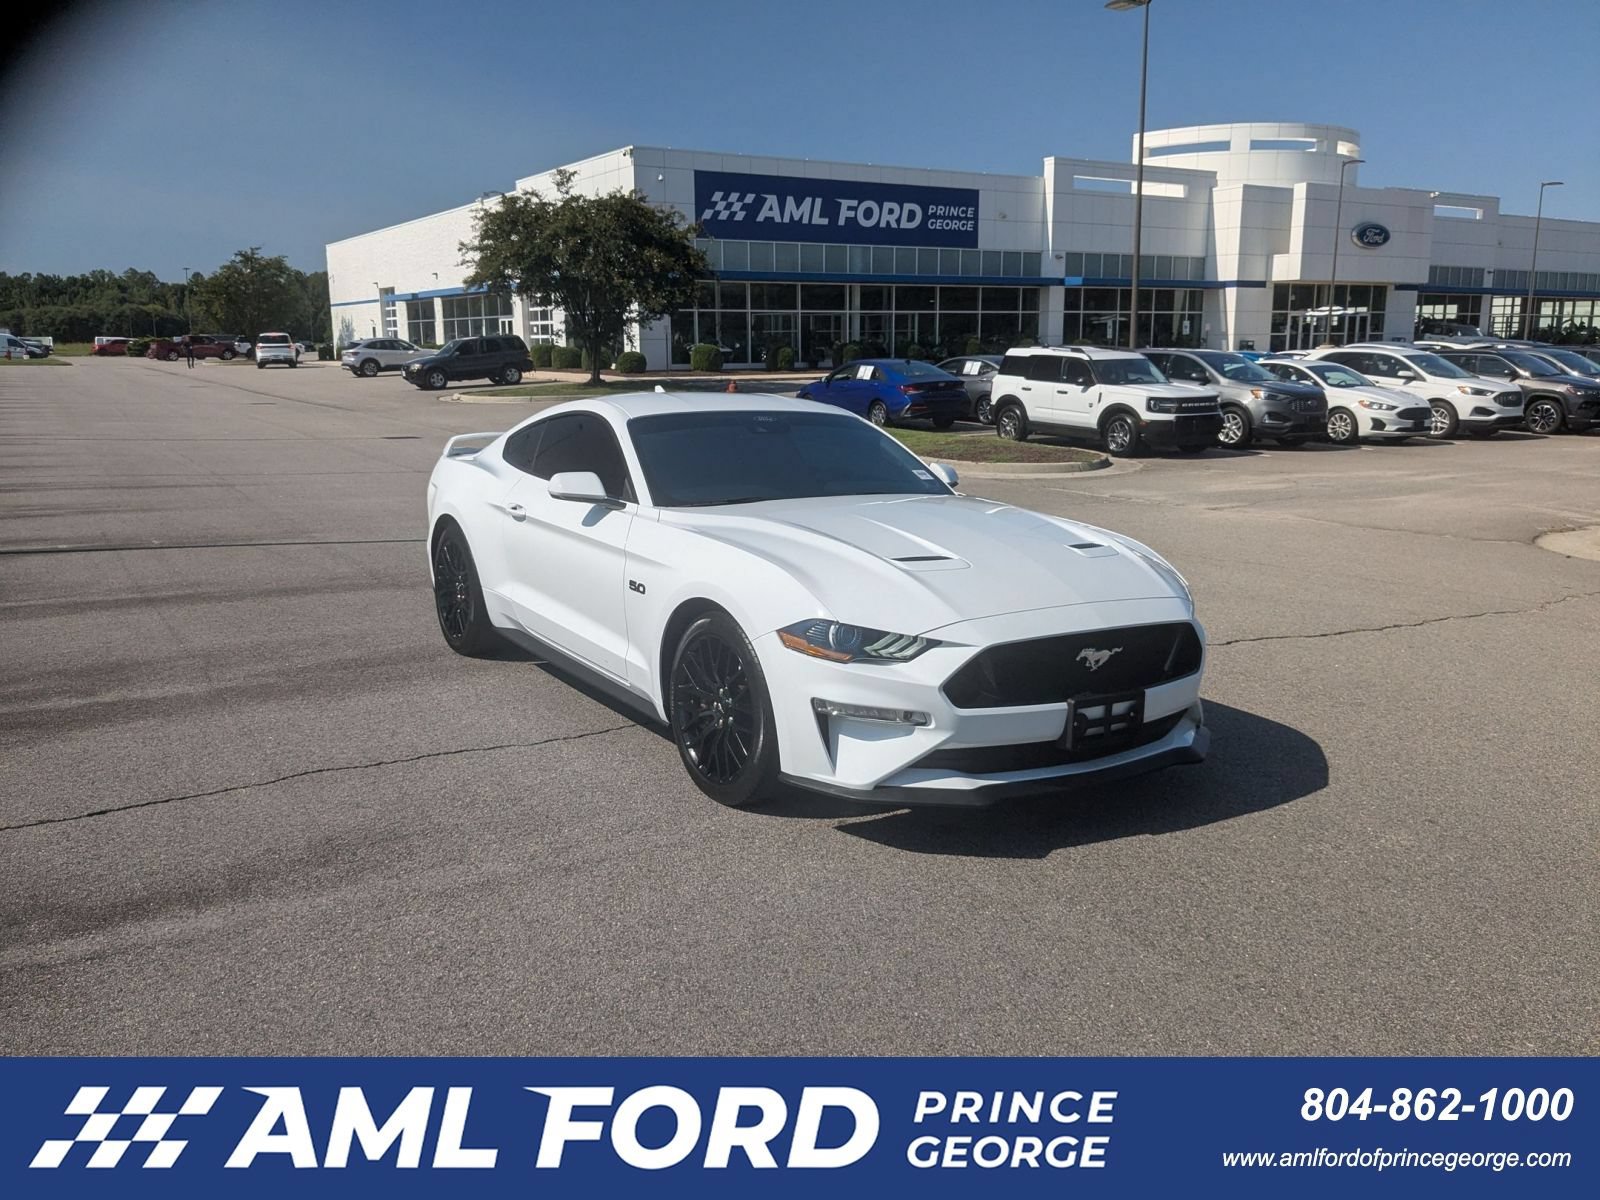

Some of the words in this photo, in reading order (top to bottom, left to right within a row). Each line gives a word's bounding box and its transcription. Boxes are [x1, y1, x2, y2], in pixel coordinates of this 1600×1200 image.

[755, 194, 829, 225] AML
[833, 198, 923, 229] FORD
[927, 205, 975, 217] PRINCE
[927, 219, 975, 230] GEORGE
